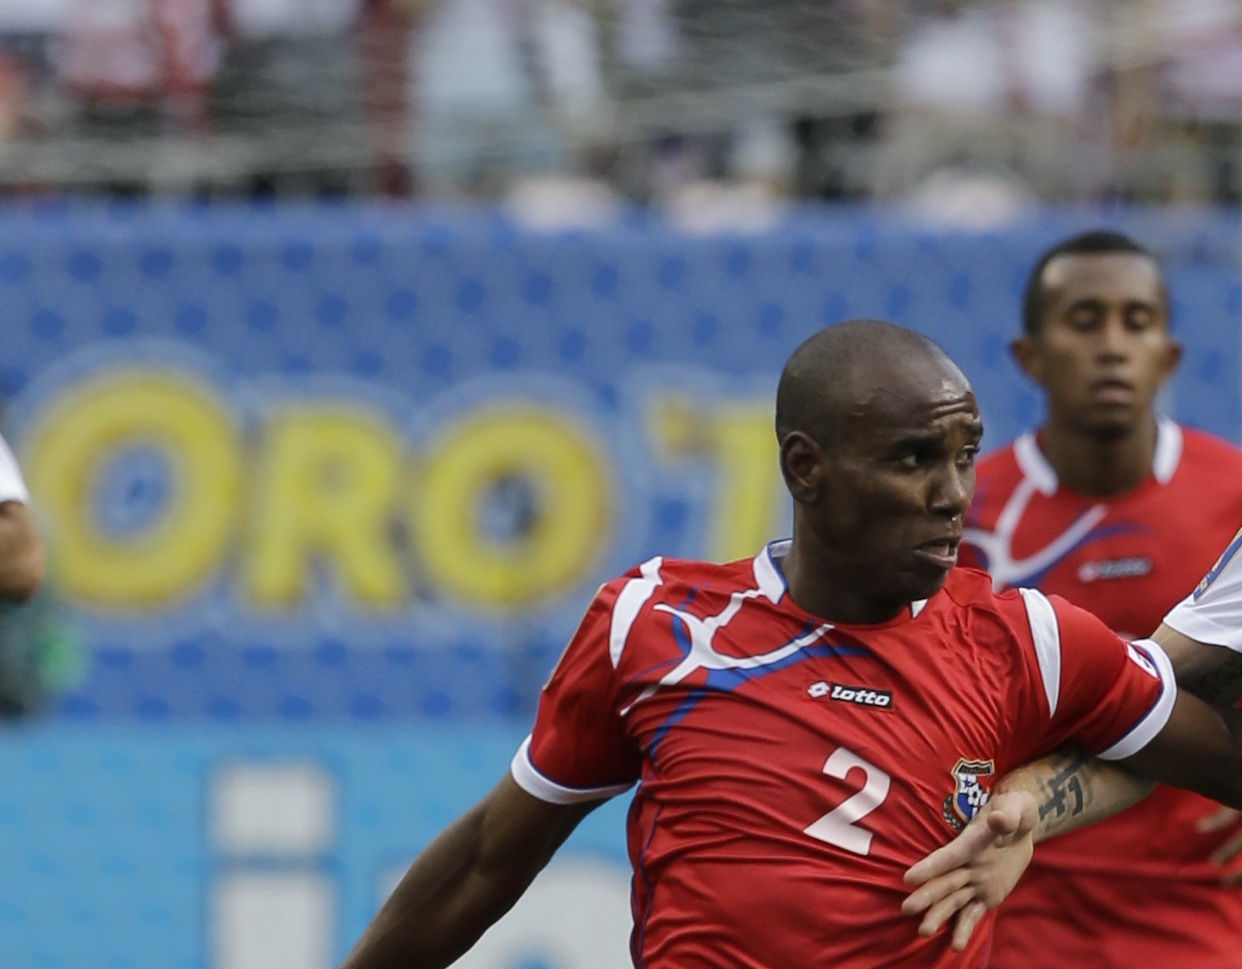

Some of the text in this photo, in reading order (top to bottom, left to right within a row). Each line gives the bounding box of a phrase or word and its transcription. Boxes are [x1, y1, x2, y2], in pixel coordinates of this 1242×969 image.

[28, 366, 604, 614] ORO
[831, 685, 890, 706] lotto
[803, 746, 891, 856] 2
